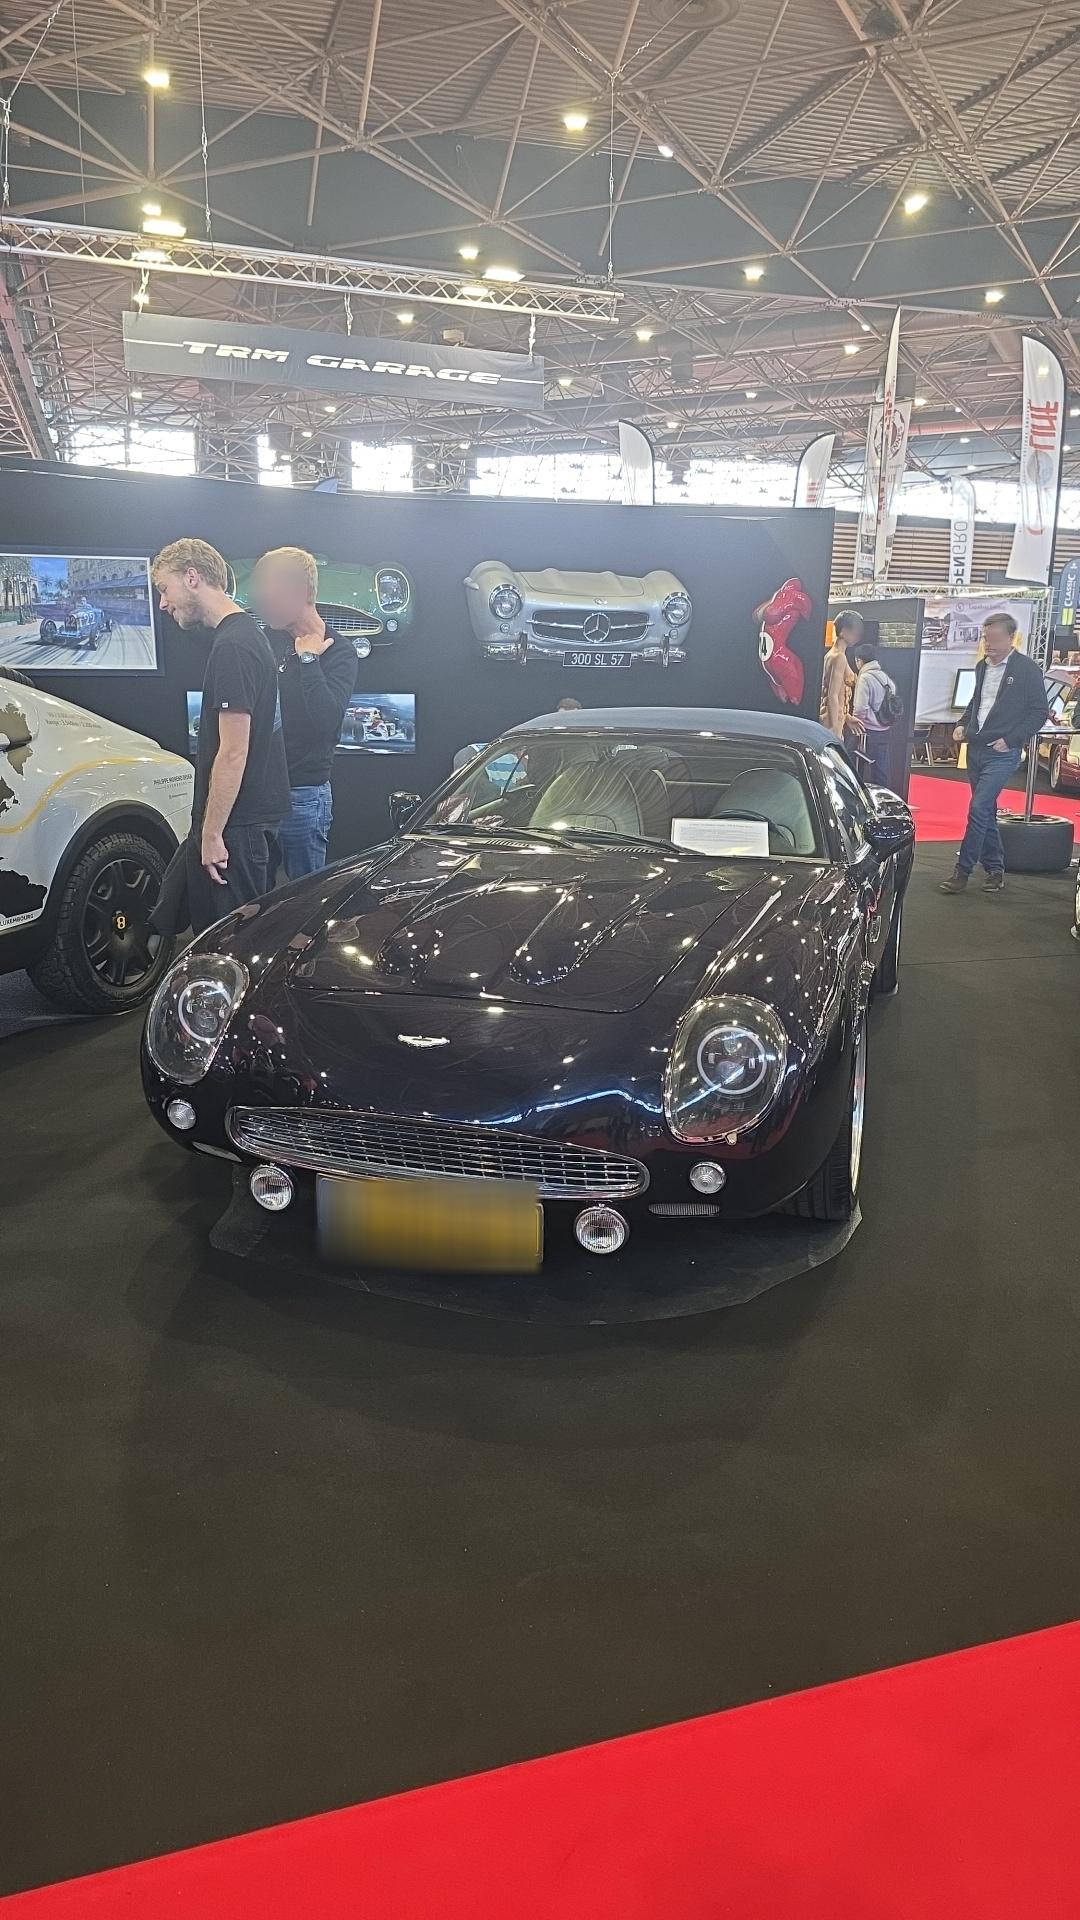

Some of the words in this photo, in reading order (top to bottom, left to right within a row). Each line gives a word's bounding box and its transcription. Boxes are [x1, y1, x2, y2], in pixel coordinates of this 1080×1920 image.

[182, 340, 289, 363] TRM
[306, 354, 502, 385] GARAGE
[84, 612, 96, 626] 22
[571, 653, 591, 665] 300
[594, 653, 607, 665] SL
[610, 654, 624, 666] 57
